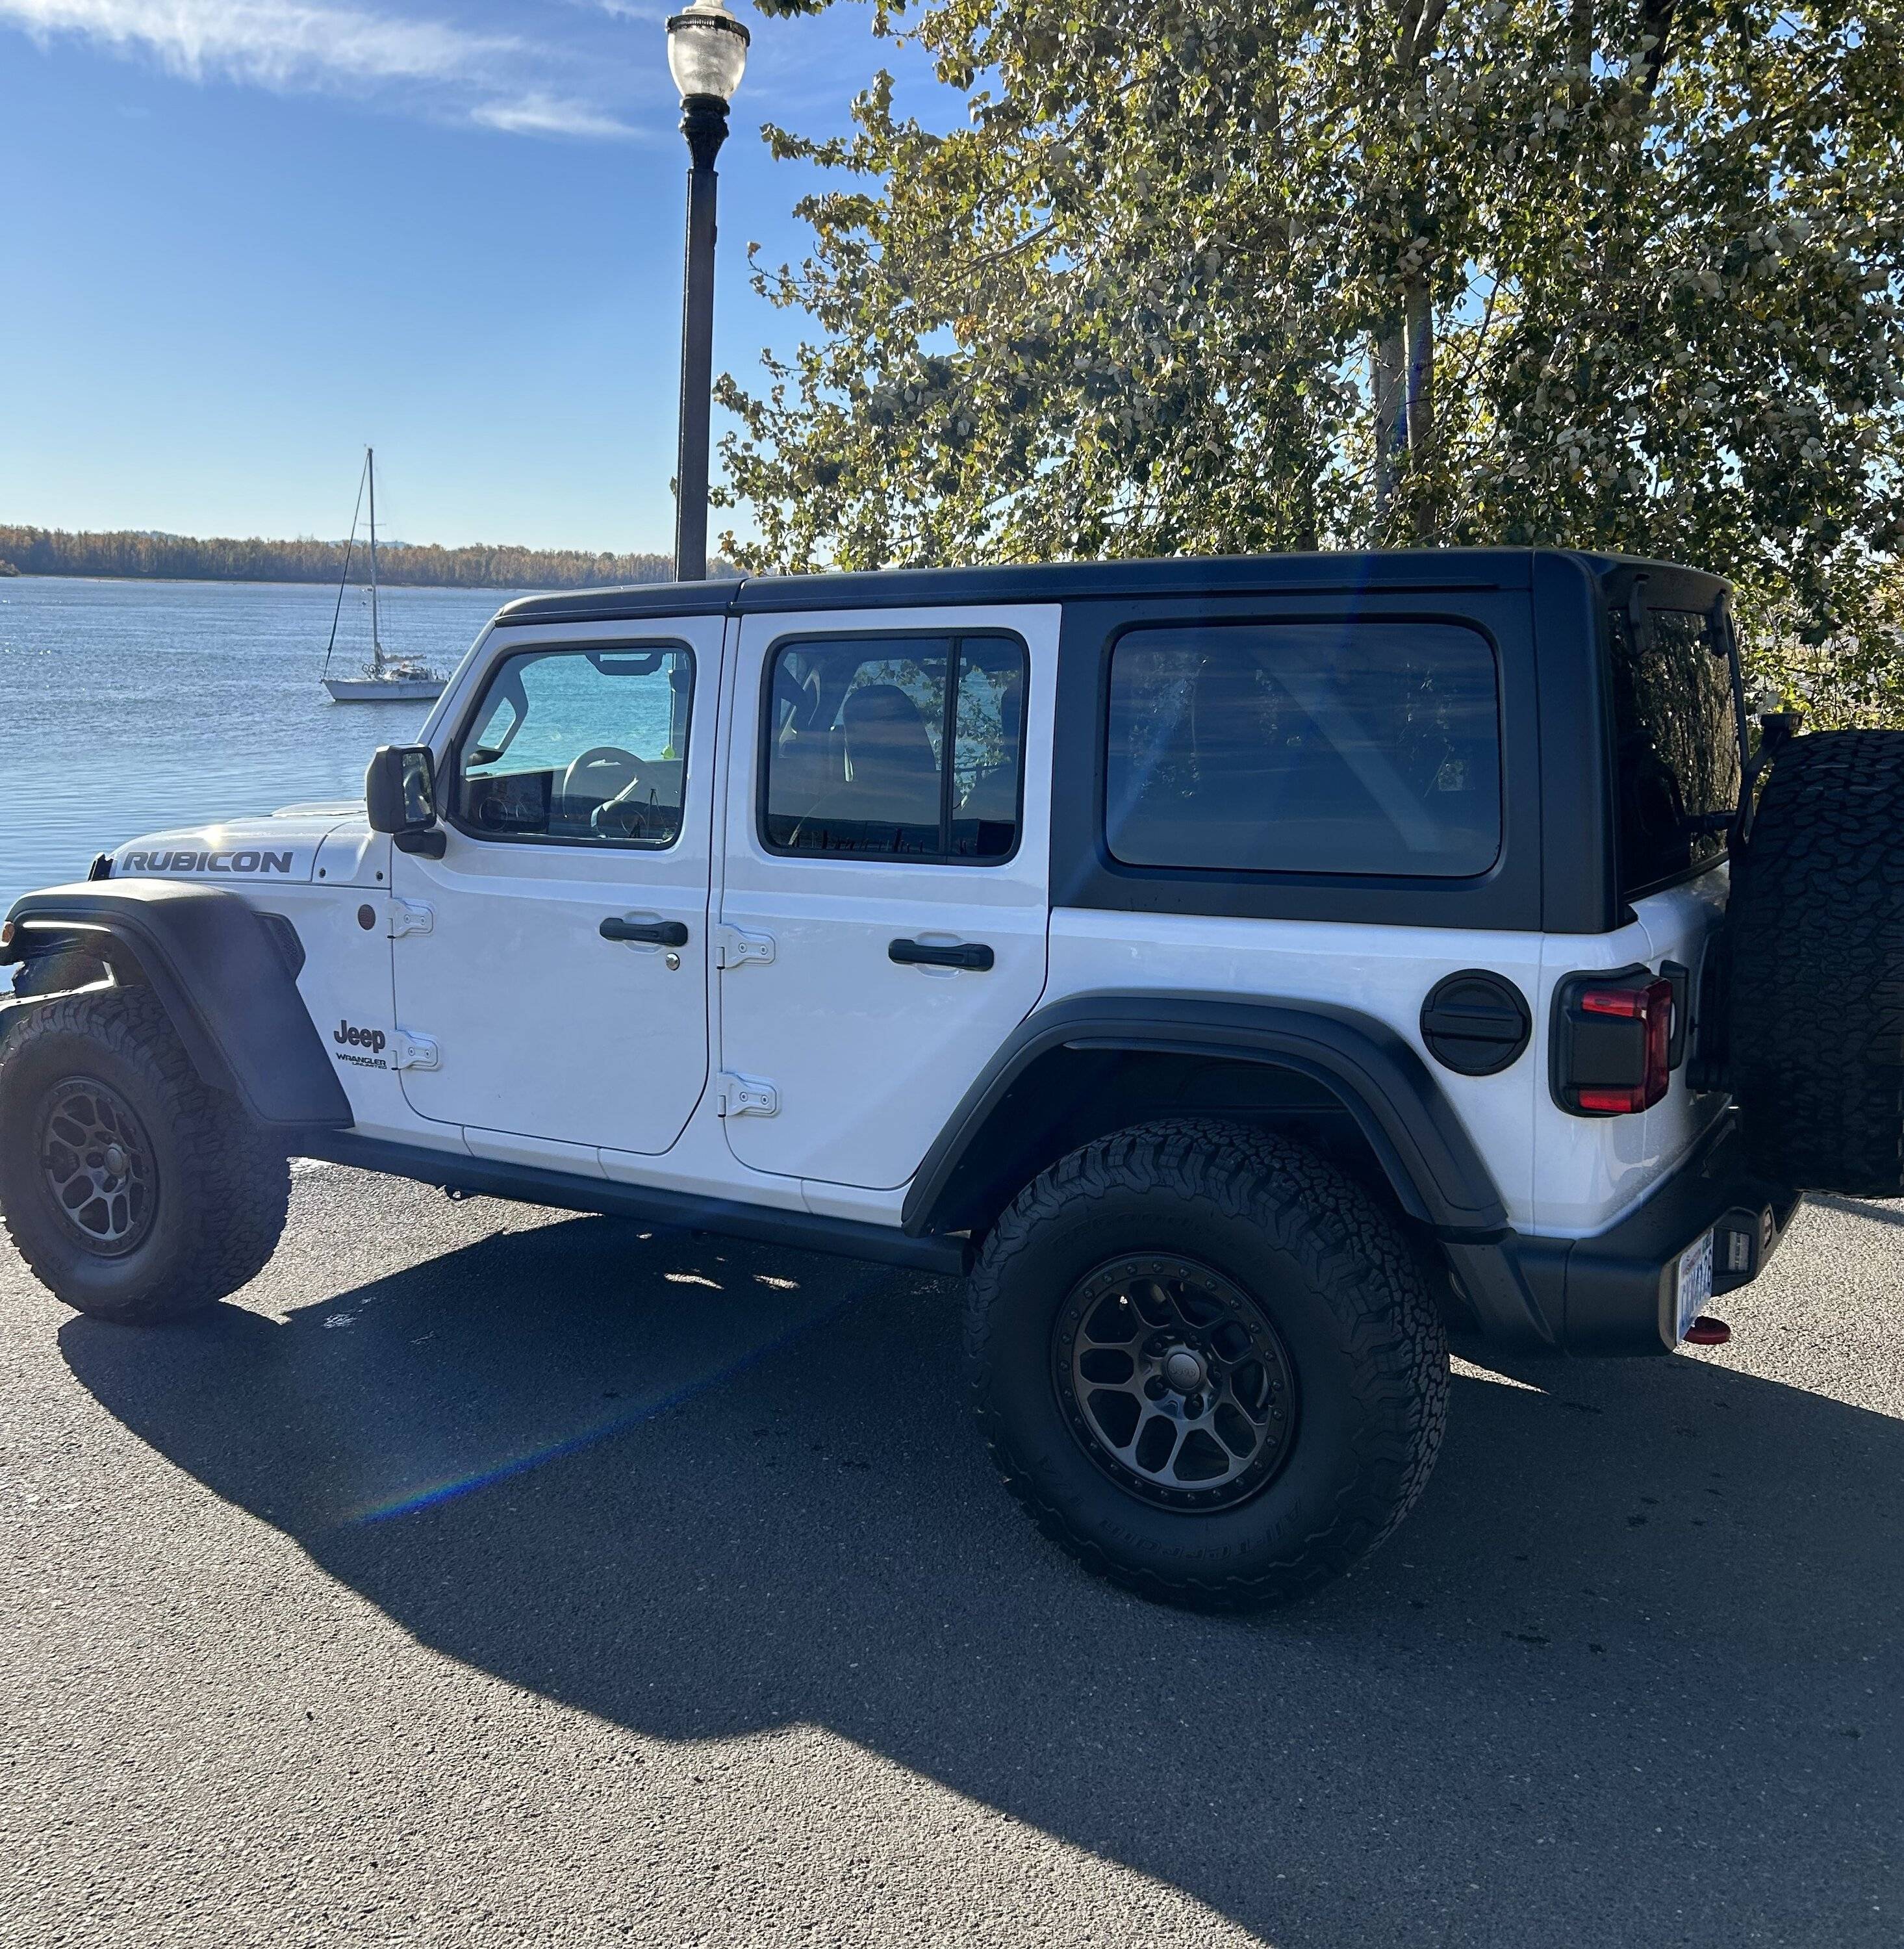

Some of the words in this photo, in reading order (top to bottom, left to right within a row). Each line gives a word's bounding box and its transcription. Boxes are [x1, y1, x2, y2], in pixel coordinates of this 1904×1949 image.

[122, 851, 294, 873] RUBICON
[334, 1019, 386, 1054] Jeep
[336, 1052, 387, 1066] WRANGLER
